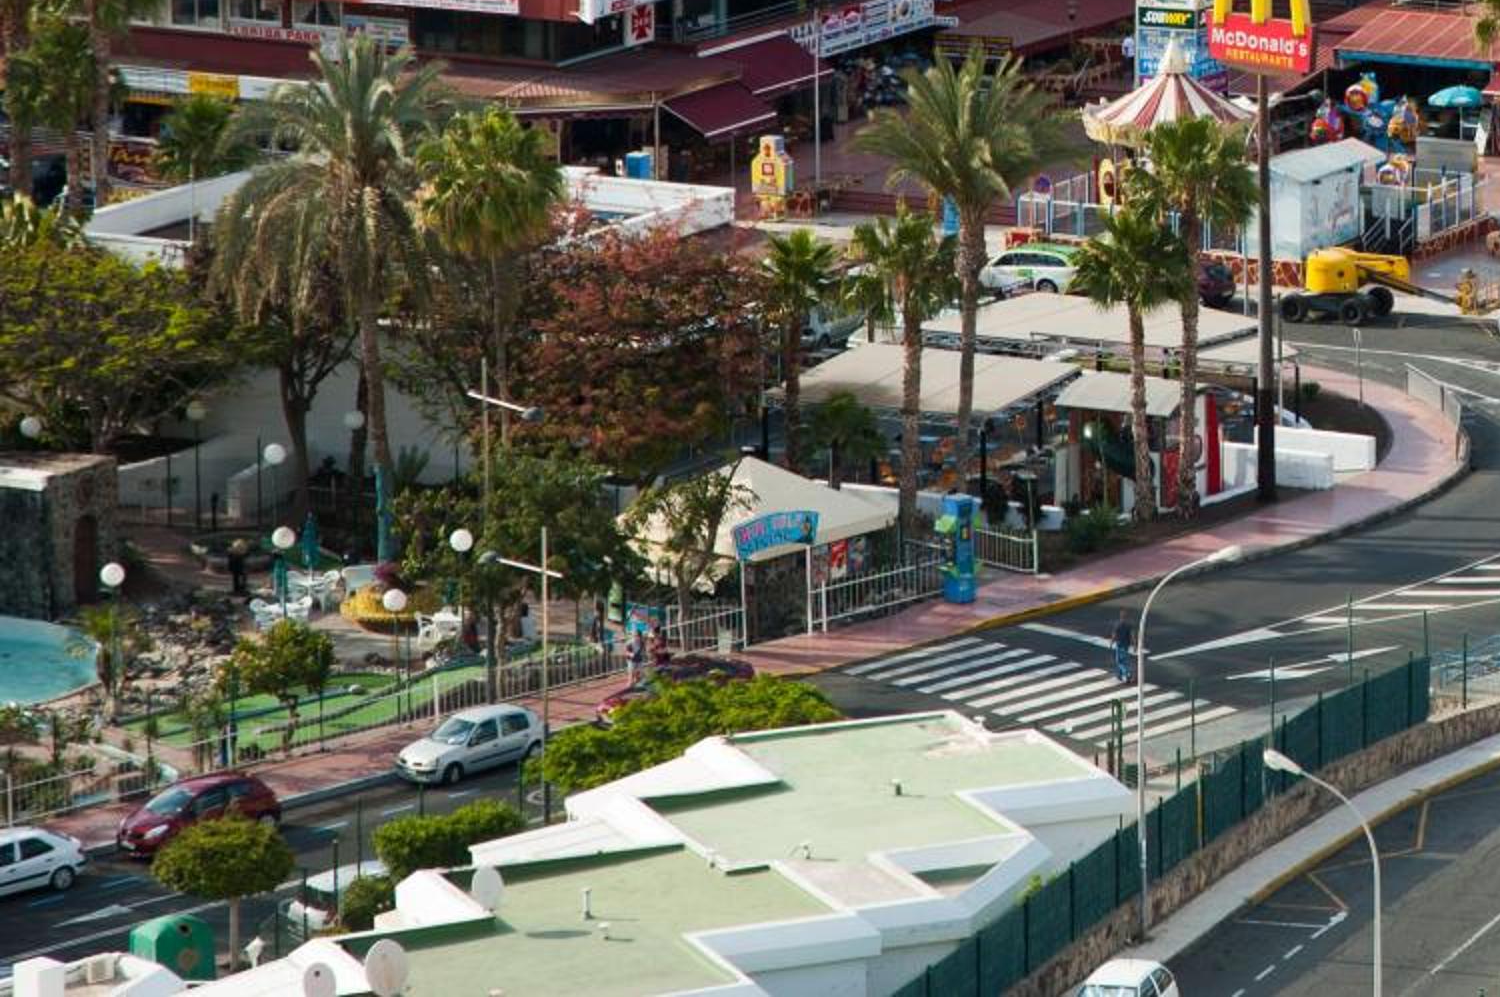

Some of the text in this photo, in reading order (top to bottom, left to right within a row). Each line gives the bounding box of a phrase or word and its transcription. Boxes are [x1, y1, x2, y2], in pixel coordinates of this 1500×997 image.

[1142, 11, 1190, 26] SUBWAY
[1210, 27, 1308, 57] McDonald's
[1225, 48, 1294, 69] RESTAURANTE
